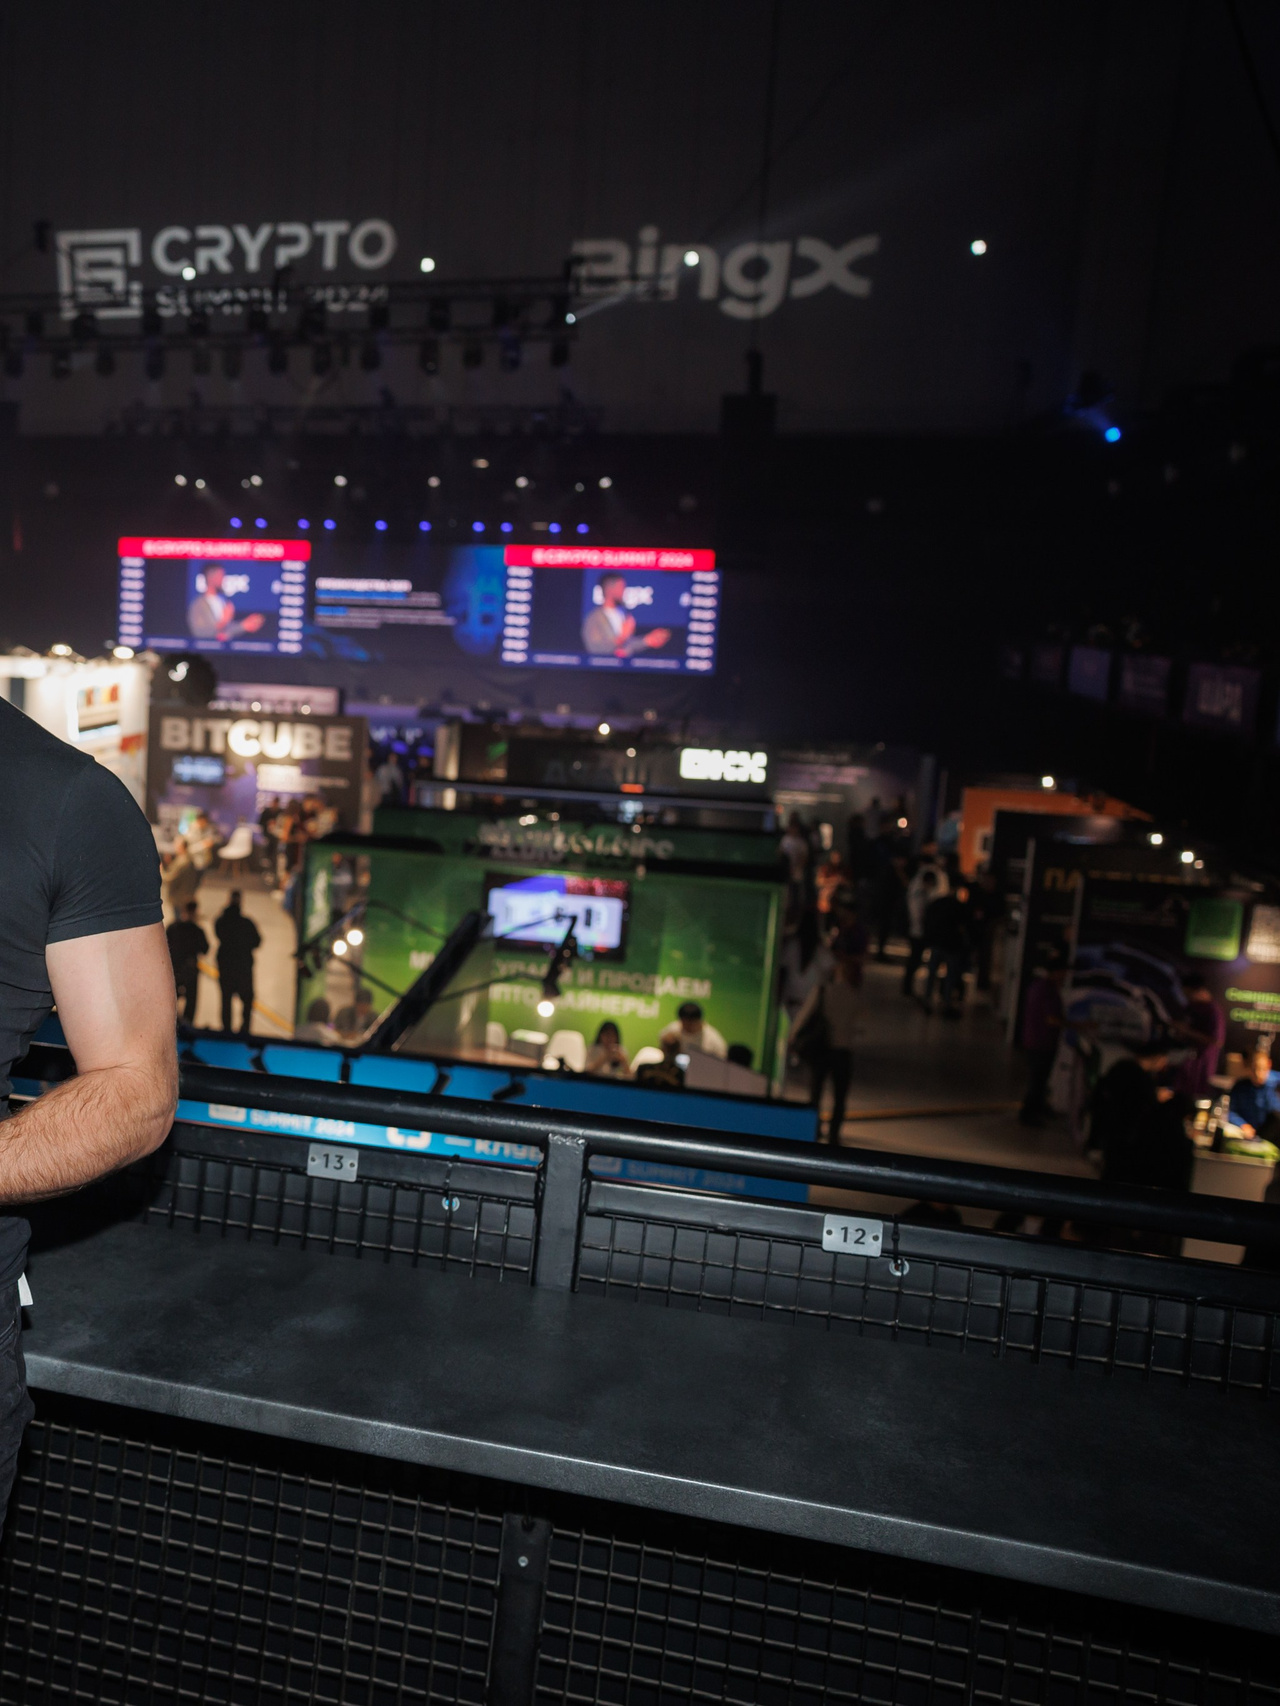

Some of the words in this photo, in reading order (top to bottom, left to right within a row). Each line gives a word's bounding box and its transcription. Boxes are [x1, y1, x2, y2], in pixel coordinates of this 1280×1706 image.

[151, 218, 398, 275] CRYPTO
[160, 716, 353, 762] BITCUBE
[322, 1152, 345, 1171] 13
[839, 1225, 867, 1246] 12
